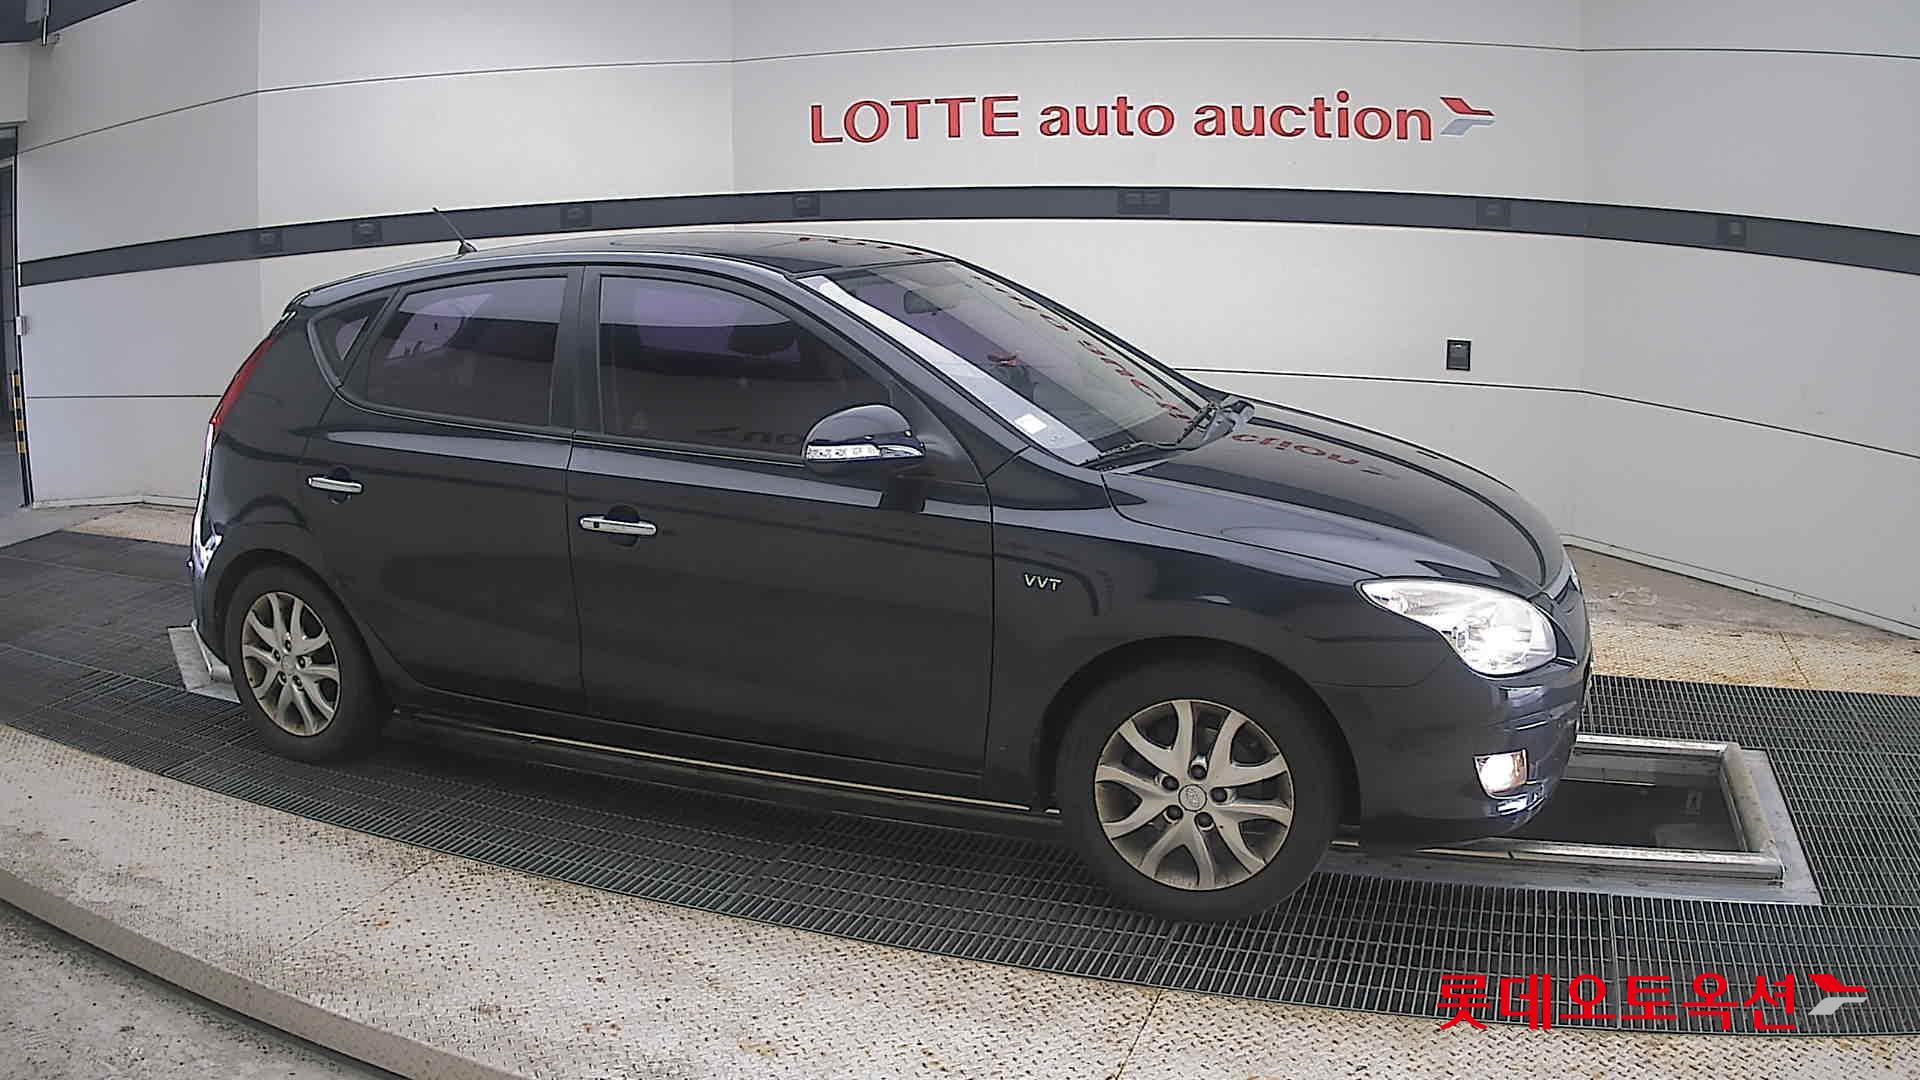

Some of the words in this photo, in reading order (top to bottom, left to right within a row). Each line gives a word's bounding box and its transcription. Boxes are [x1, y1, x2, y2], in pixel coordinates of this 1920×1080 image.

[809, 95, 1018, 144] LOTTE
[1039, 95, 1177, 138] auto
[1193, 90, 1434, 142] auction
[1023, 573, 1063, 591] VVT
